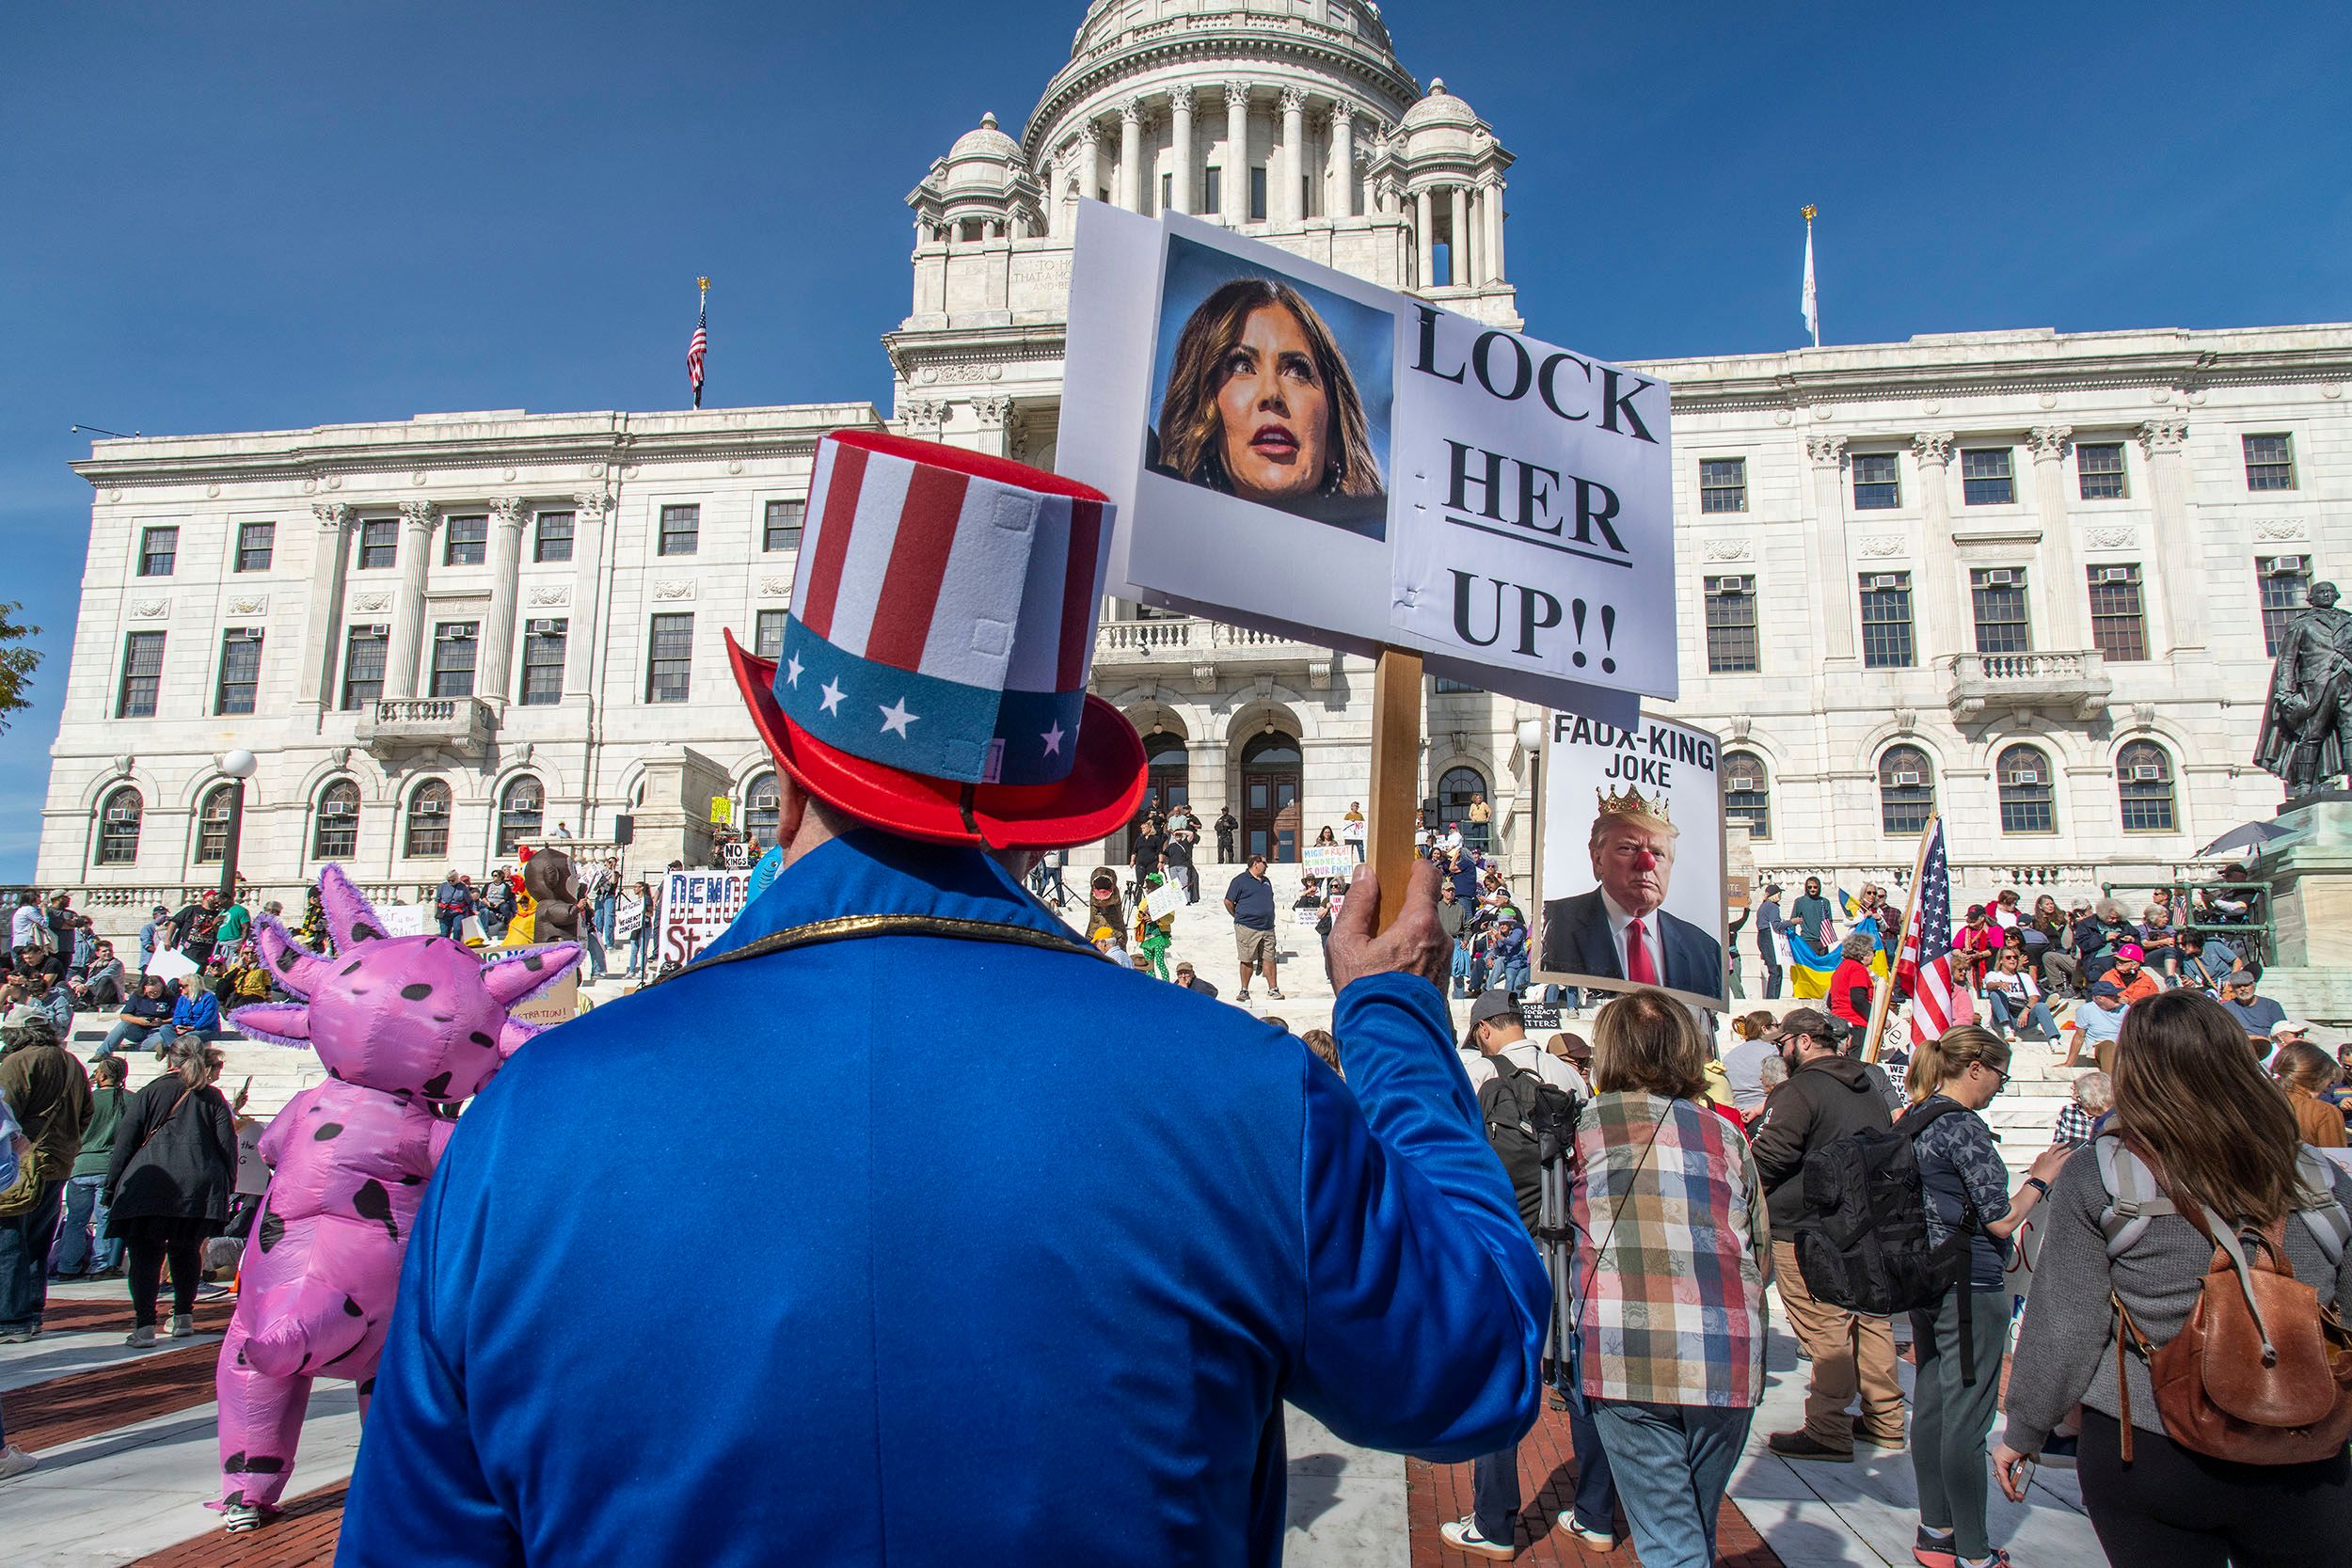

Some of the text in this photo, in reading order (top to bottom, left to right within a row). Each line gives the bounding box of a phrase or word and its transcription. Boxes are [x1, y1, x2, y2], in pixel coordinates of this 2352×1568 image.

[1014, 272, 1042, 282] THAT
[1410, 303, 1660, 445] LOCK
[1441, 438, 1629, 554] HER
[1447, 568, 1617, 674] UP!!
[1554, 714, 1714, 771] FAUX-KING
[1605, 753, 1672, 788] JOKE
[725, 845, 743, 858] NO
[1305, 857, 1349, 866] KINDNESS
[1314, 866, 1330, 875] OUR
[1889, 1065, 1904, 1073] WE
[241, 1141, 255, 1149] the
